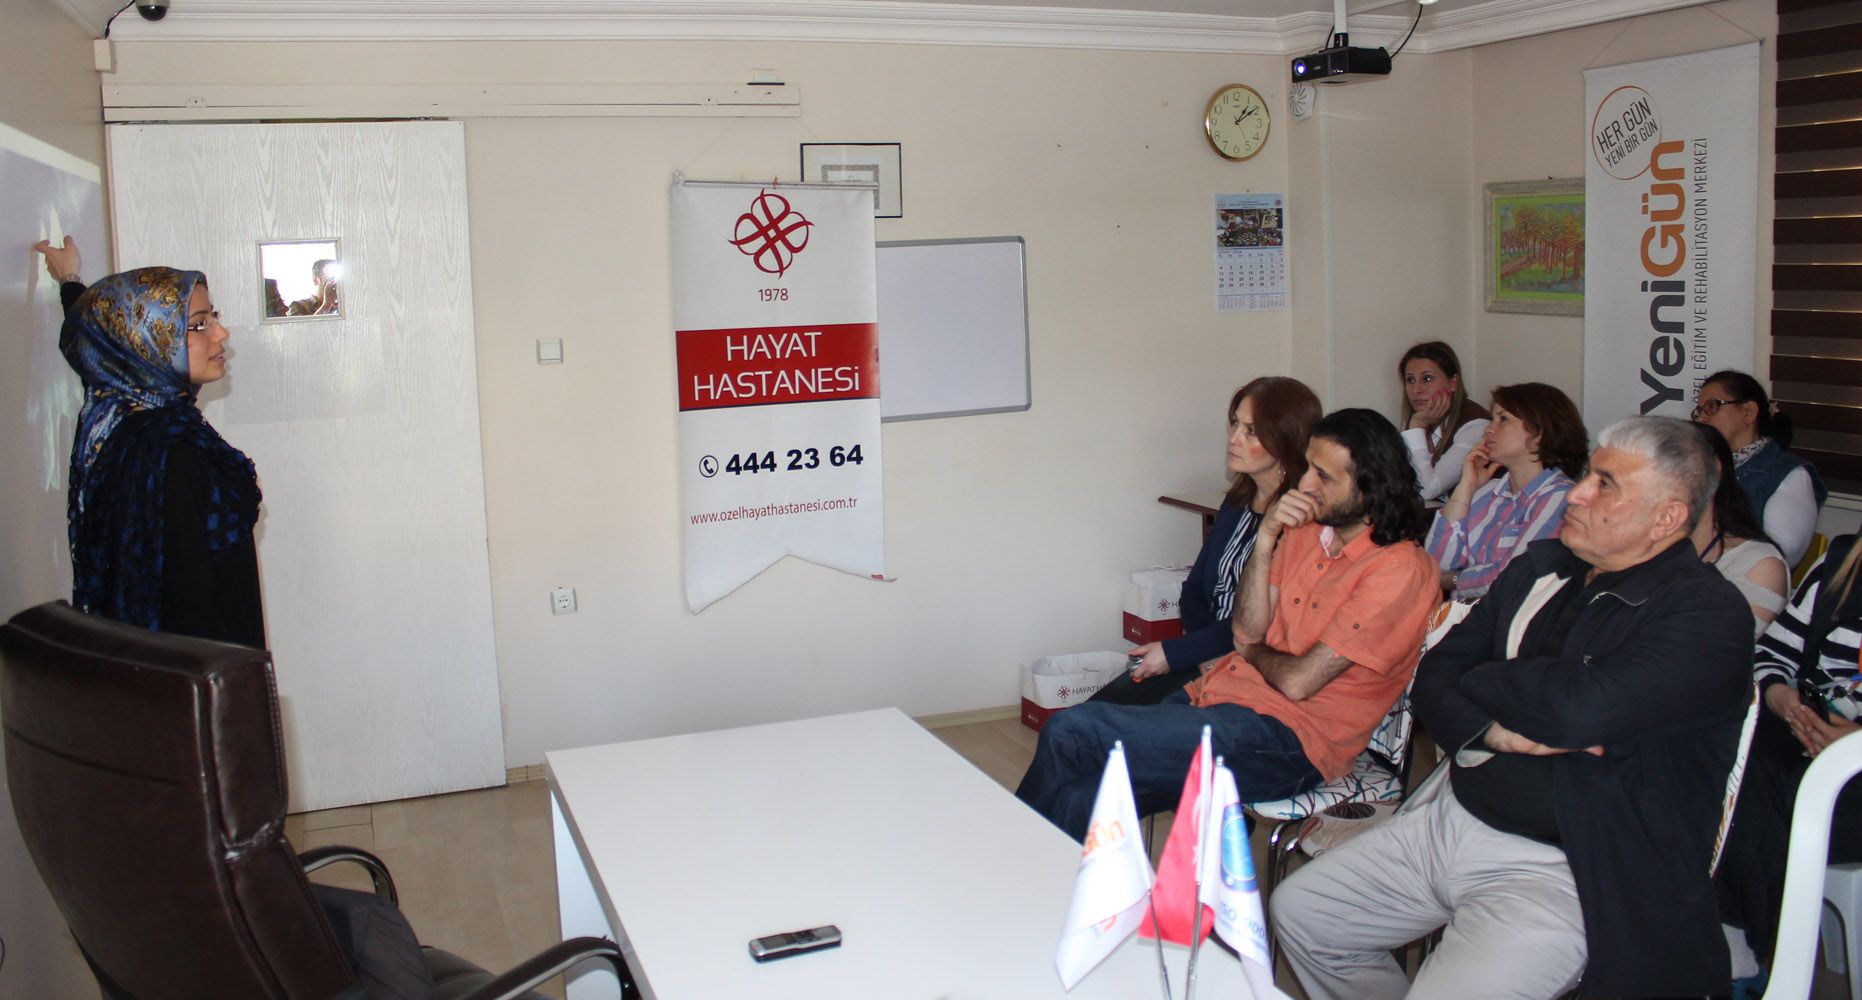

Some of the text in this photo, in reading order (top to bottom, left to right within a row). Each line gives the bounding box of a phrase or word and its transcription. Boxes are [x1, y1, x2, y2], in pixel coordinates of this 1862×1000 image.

[1233, 92, 1240, 101] 12
[1256, 118, 1262, 128] 3
[1596, 97, 1651, 153] HER GÜN
[1640, 118, 1658, 142] GÜN
[1214, 131, 1220, 140] 8
[1222, 141, 1228, 150] 7
[1234, 144, 1240, 154] 6
[1245, 141, 1251, 151] 5
[1691, 138, 1707, 193] MERKEZİ
[1692, 198, 1708, 303] REHABİLİTASYON
[758, 287, 789, 302] 1978
[1694, 308, 1707, 323] VE
[726, 331, 822, 361] HAYAT
[1691, 328, 1707, 370] EĞİTİM
[726, 445, 864, 476] 444 23 64
[690, 497, 858, 525] www.ozelhayathastanesi.com.tr
[1072, 686, 1096, 695] HAYAT
